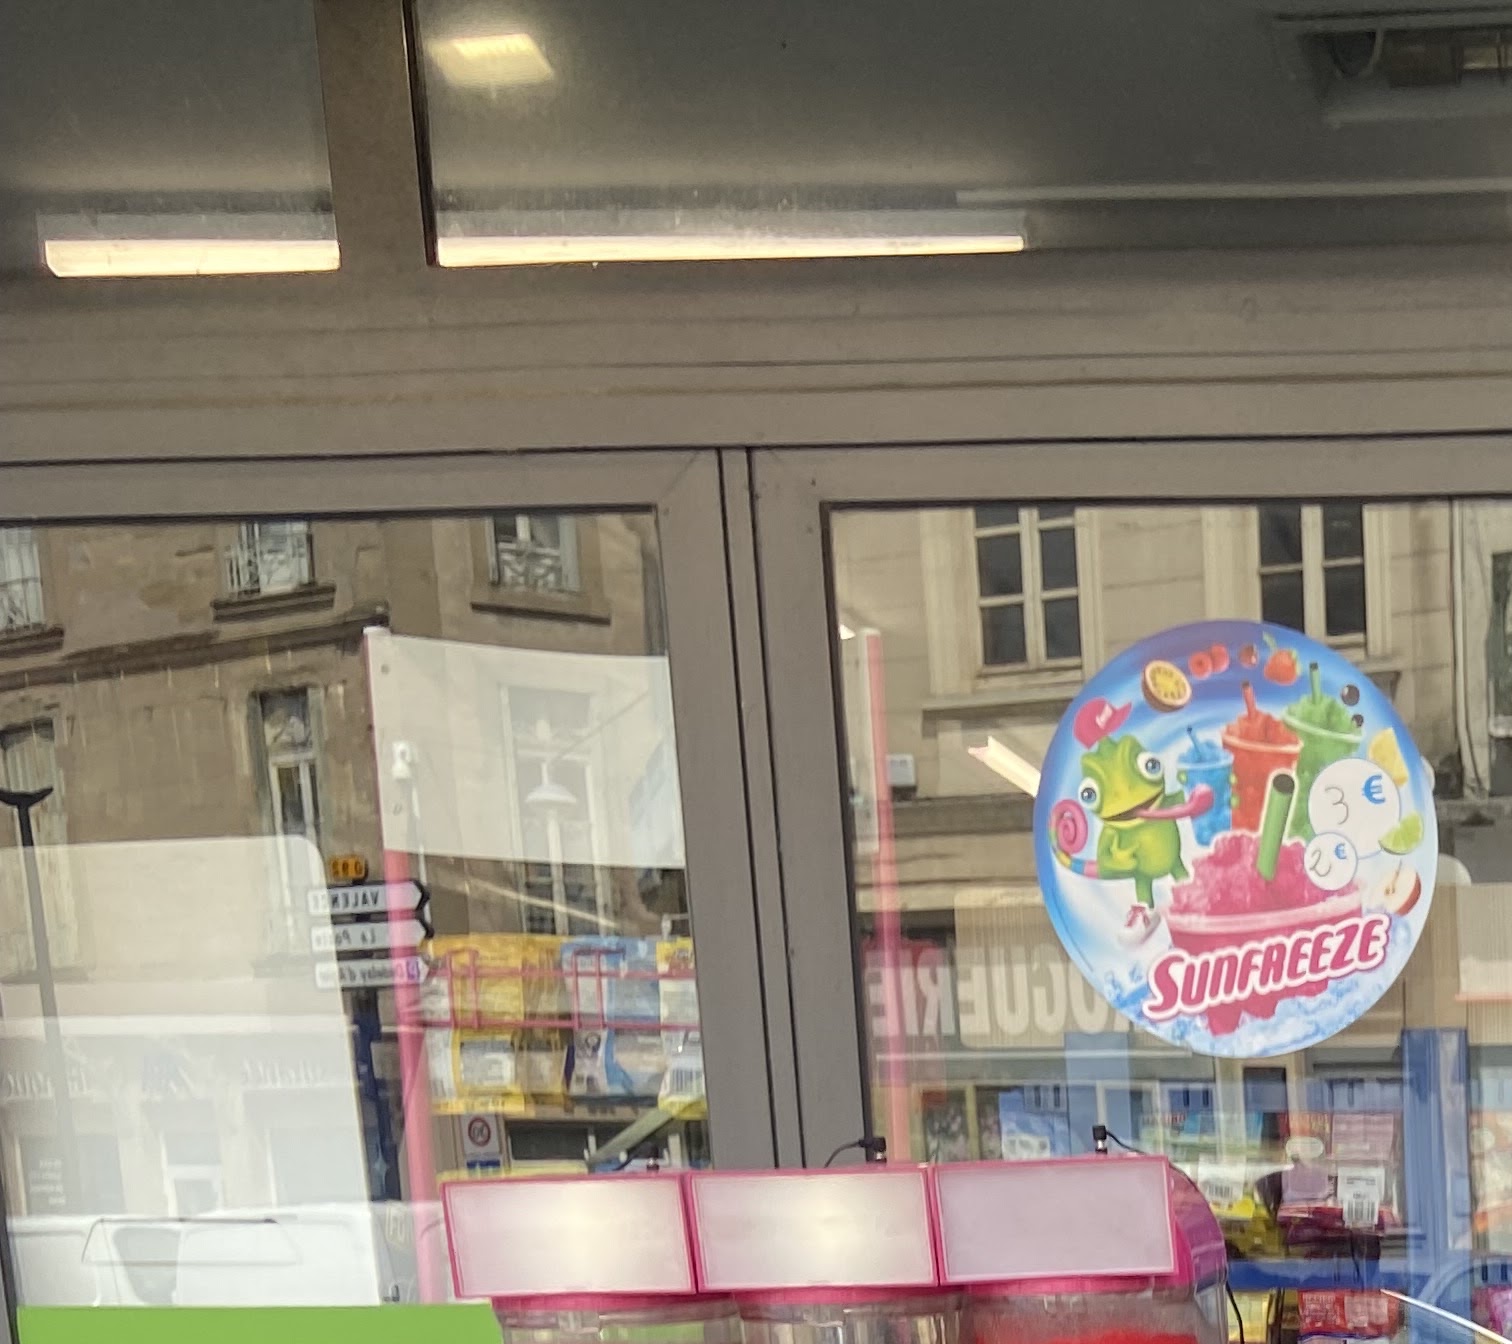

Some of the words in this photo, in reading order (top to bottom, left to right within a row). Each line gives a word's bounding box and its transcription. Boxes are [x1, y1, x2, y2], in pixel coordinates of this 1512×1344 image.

[1325, 786, 1350, 825] 3
[1362, 774, 1386, 805] €
[1309, 849, 1332, 877] 2
[1145, 914, 1389, 1016] SUNFREEZE
